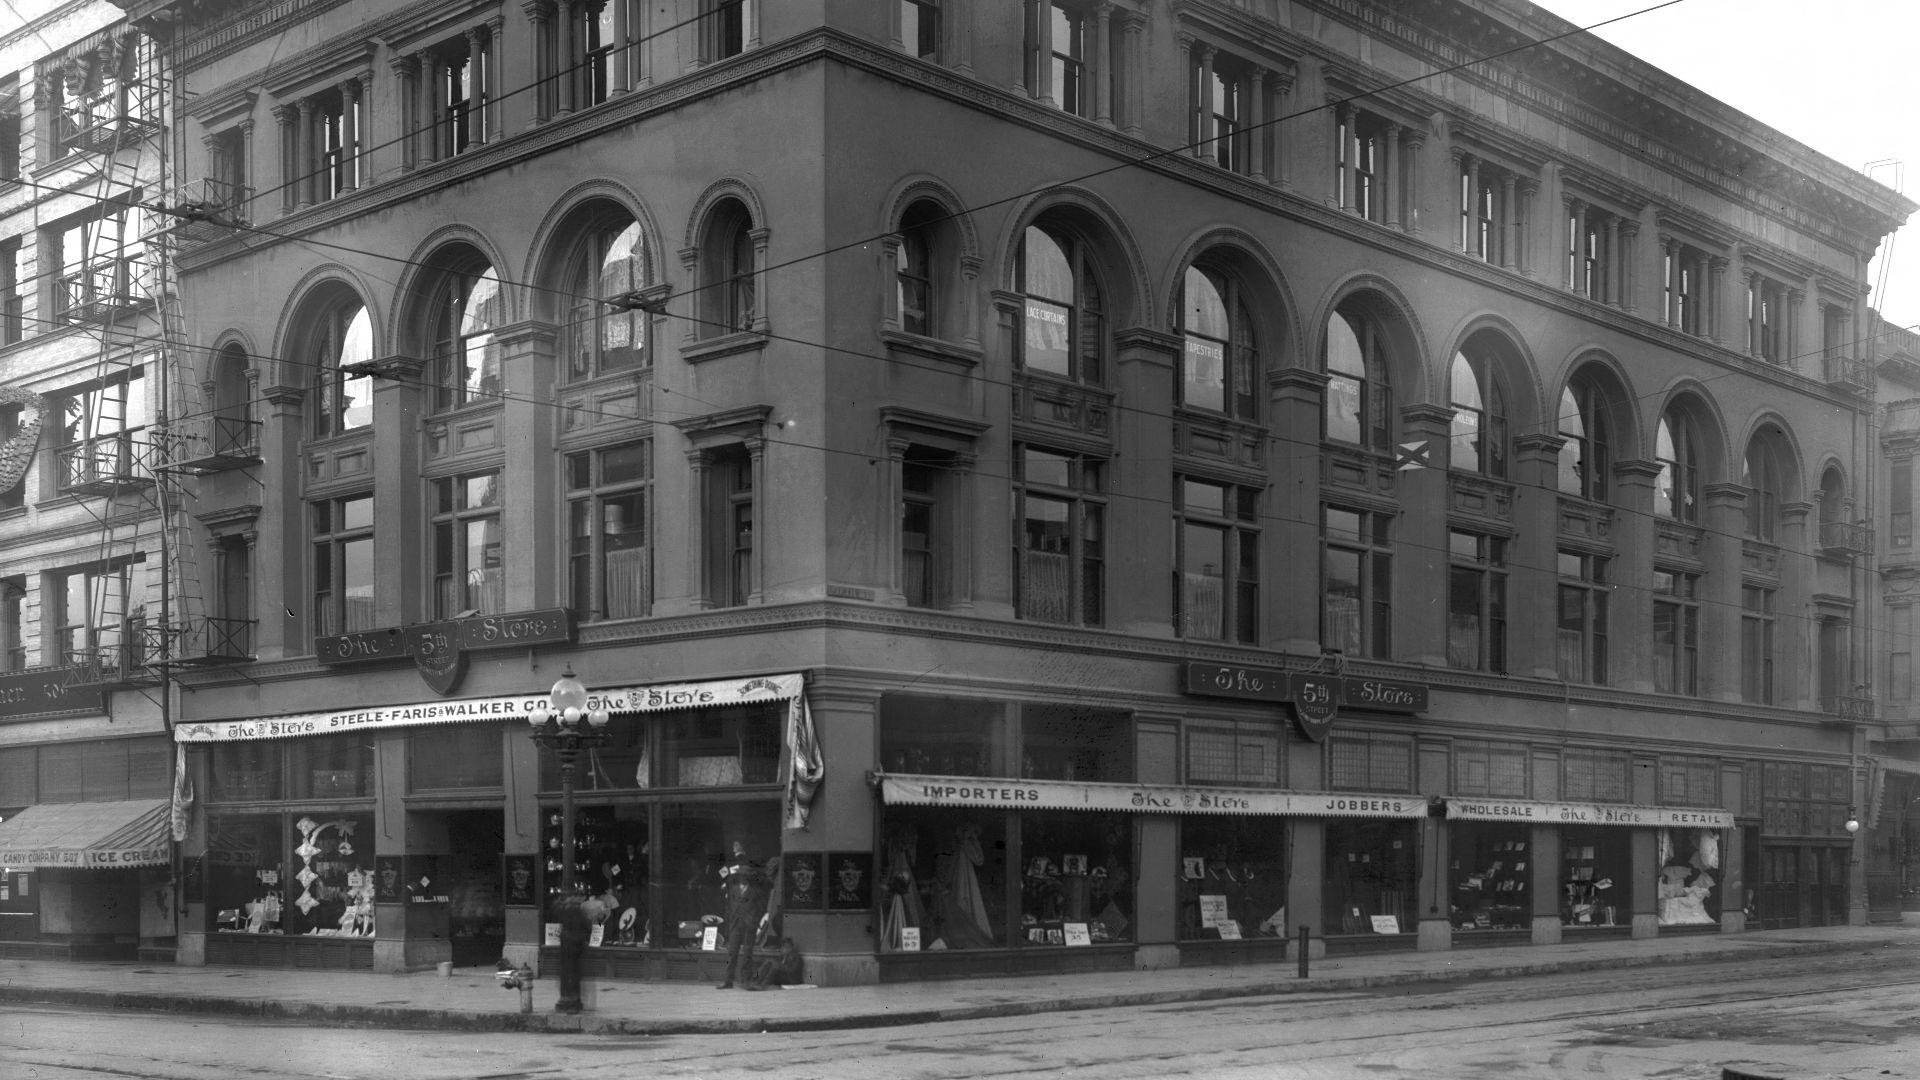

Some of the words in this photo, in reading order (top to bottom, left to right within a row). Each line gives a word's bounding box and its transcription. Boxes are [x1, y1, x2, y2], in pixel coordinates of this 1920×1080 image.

[1026, 305, 1040, 320] LACE
[1040, 310, 1066, 326] CURTAINS
[1185, 341, 1223, 360] TAPESTRIES
[338, 633, 381, 658] The
[482, 617, 547, 641] Store
[1215, 667, 1264, 692] The
[1303, 682, 1329, 704] 5th
[1360, 681, 1414, 705] Store
[228, 723, 255, 738] The
[444, 702, 515, 716] WALKER
[586, 694, 625, 711] The
[923, 785, 1039, 801] IMPORTERS
[1131, 792, 1177, 807] The
[1326, 799, 1401, 812] JOBBERS
[1461, 804, 1532, 818] WHOLESALE
[1560, 807, 1587, 821] The
[1672, 813, 1721, 824] RETAIL
[3, 852, 26, 864] CANDY
[28, 851, 60, 863] COMPANY
[63, 852, 79, 863] 507
[91, 852, 118, 863] ICE
[121, 848, 169, 863] CREAM
